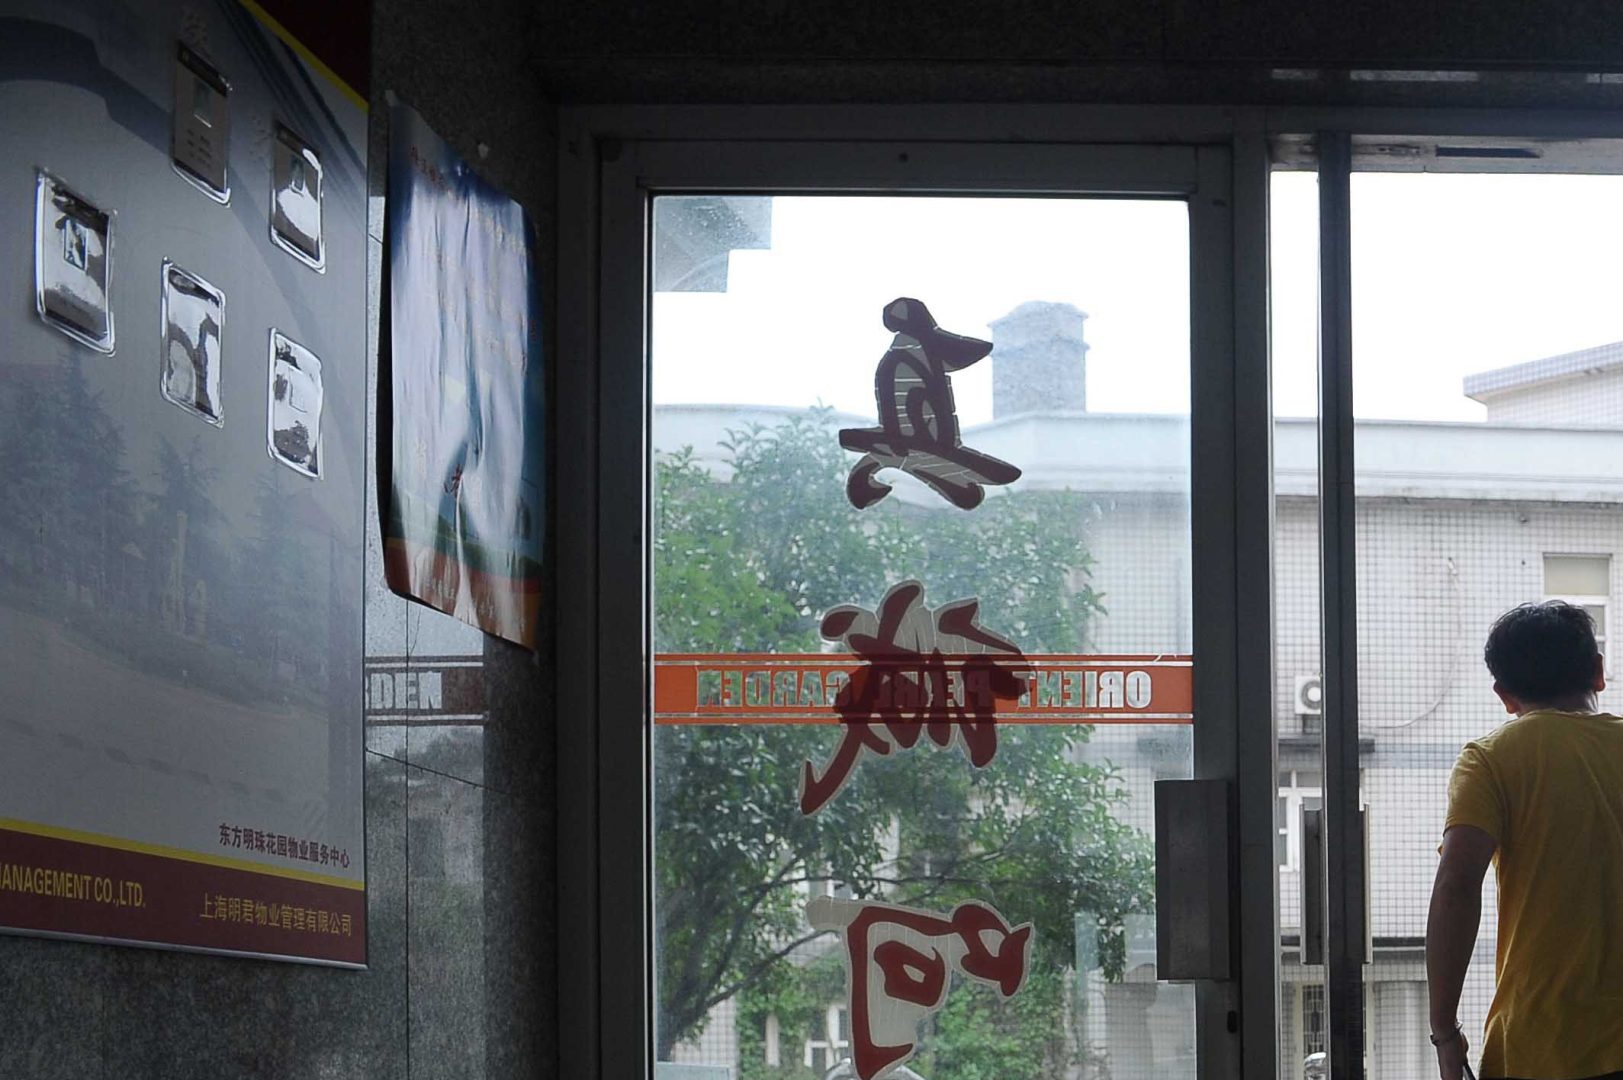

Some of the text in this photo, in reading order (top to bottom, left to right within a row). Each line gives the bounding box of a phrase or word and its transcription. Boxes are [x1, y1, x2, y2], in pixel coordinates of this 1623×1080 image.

[219, 823, 350, 869] 东方明珠花园物业服务中心
[0, 864, 91, 901] ANAGEMENT
[200, 893, 352, 937] 上海明君物业管理有限公司
